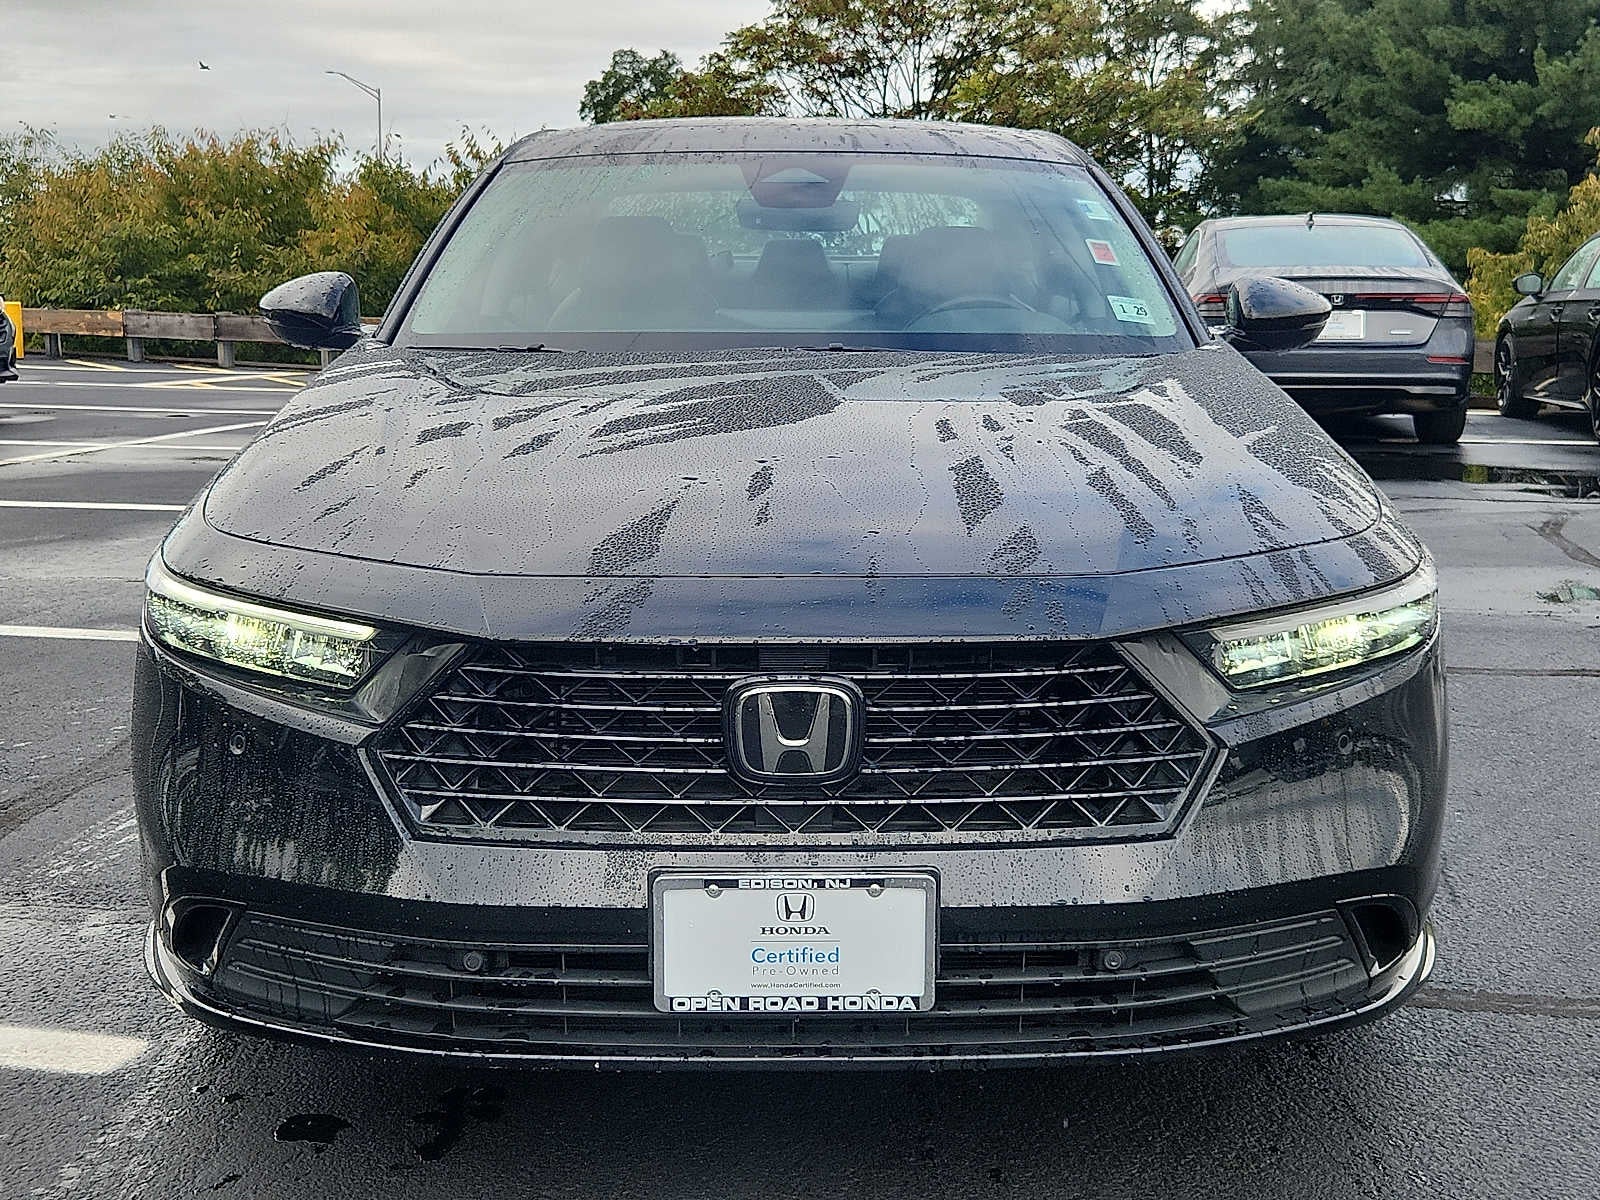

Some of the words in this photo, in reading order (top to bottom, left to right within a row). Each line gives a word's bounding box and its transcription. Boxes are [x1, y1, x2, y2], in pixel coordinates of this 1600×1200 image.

[825, 878, 851, 889] NJ
[760, 926, 831, 935] HONDA
[751, 947, 840, 964] Certified
[751, 965, 840, 976] Pre-Owned
[672, 997, 740, 1011] OPEN
[748, 997, 819, 1011] ROAD
[827, 996, 917, 1011] HONDA
